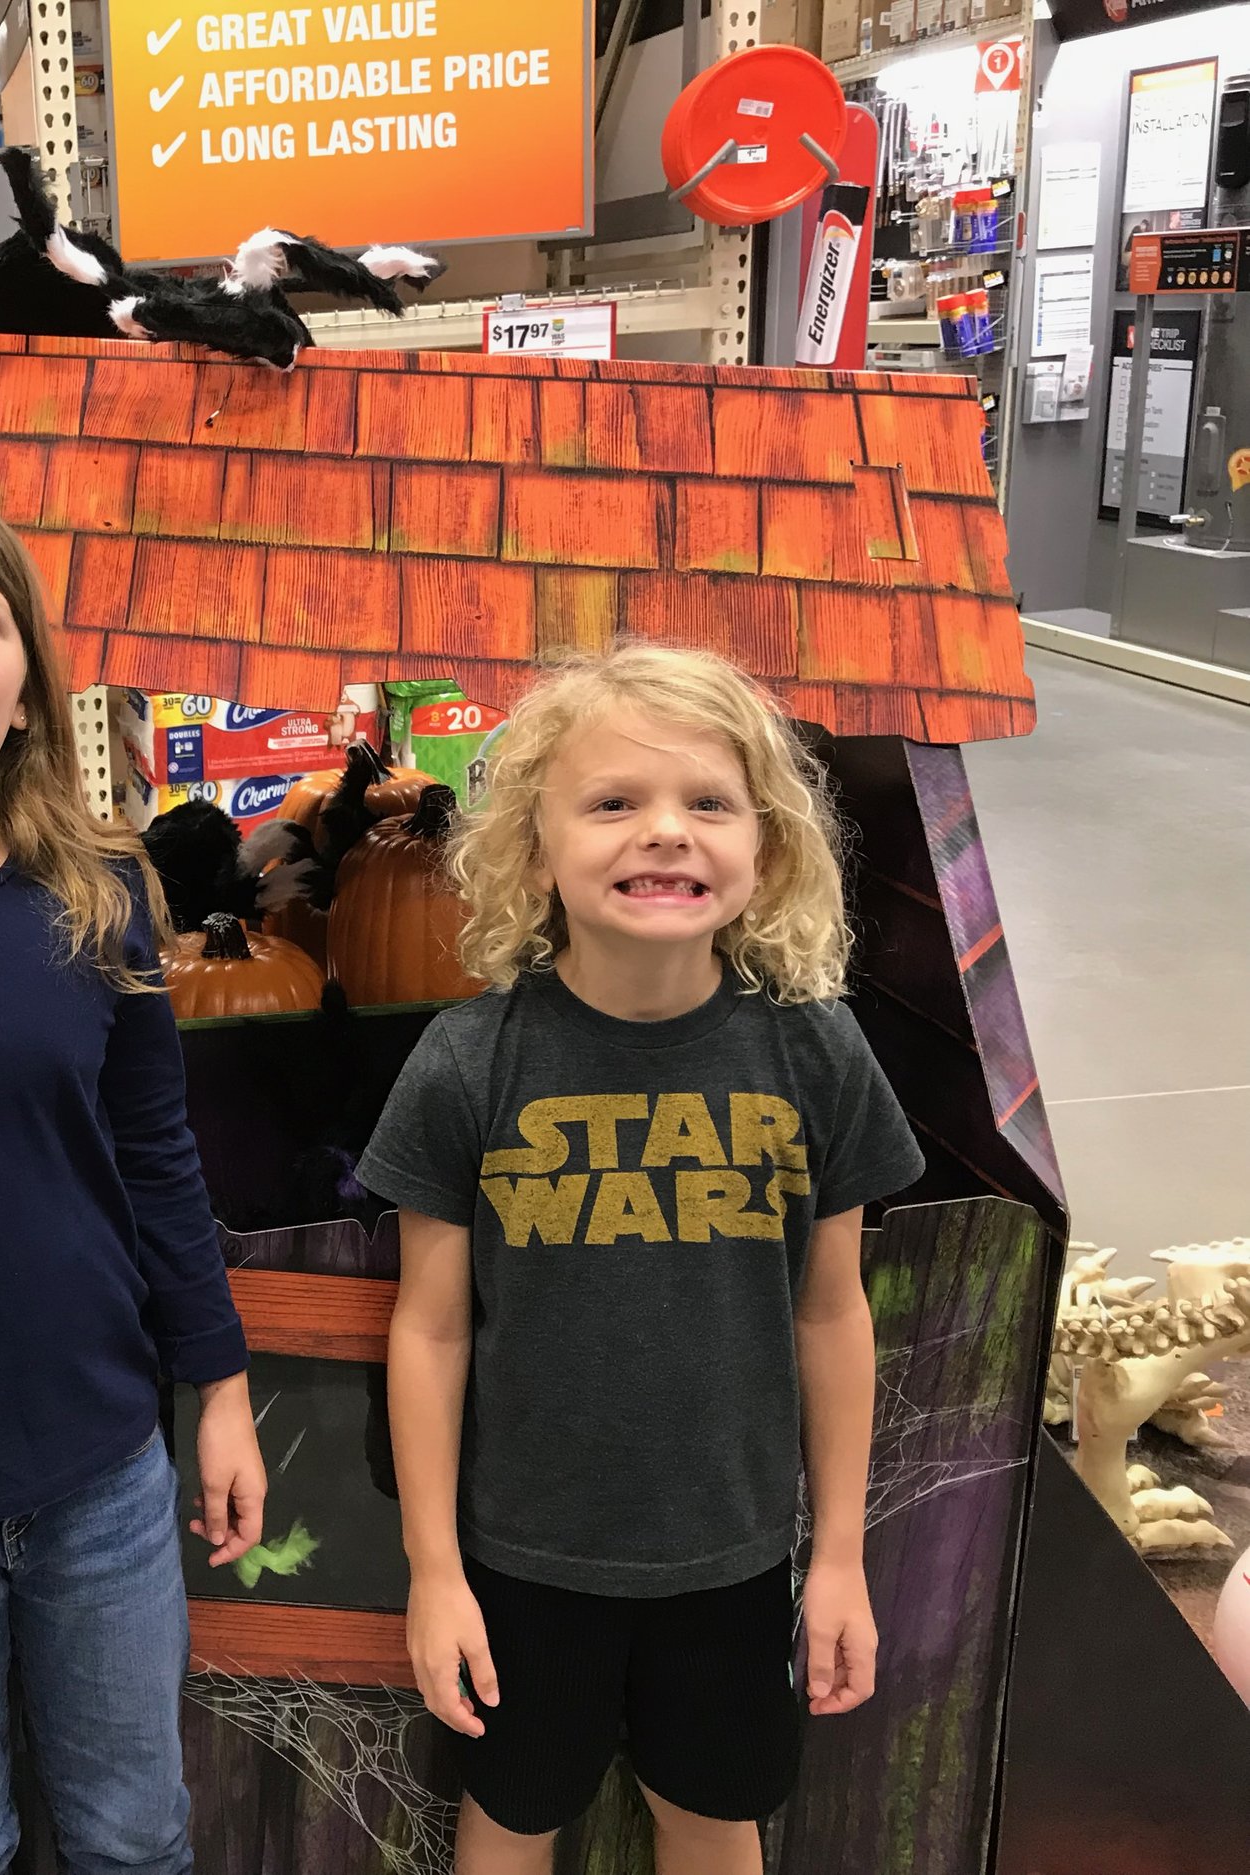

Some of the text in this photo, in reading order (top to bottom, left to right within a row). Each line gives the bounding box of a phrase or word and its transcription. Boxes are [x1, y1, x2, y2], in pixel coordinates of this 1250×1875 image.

[196, 0, 437, 52] GREAT VALUE
[198, 49, 549, 109] AFFORDABLE PRICE
[993, 56, 1001, 70] 1
[201, 112, 457, 164] LONG LASTING
[808, 241, 840, 346] Energizer
[181, 695, 212, 717] 60
[287, 718, 311, 727] ULTRA
[446, 706, 481, 730] 20
[169, 729, 200, 740] DOUBLES
[281, 724, 318, 736] STRONG
[480, 1091, 810, 1175] STAR
[479, 1169, 811, 1248] WARS
